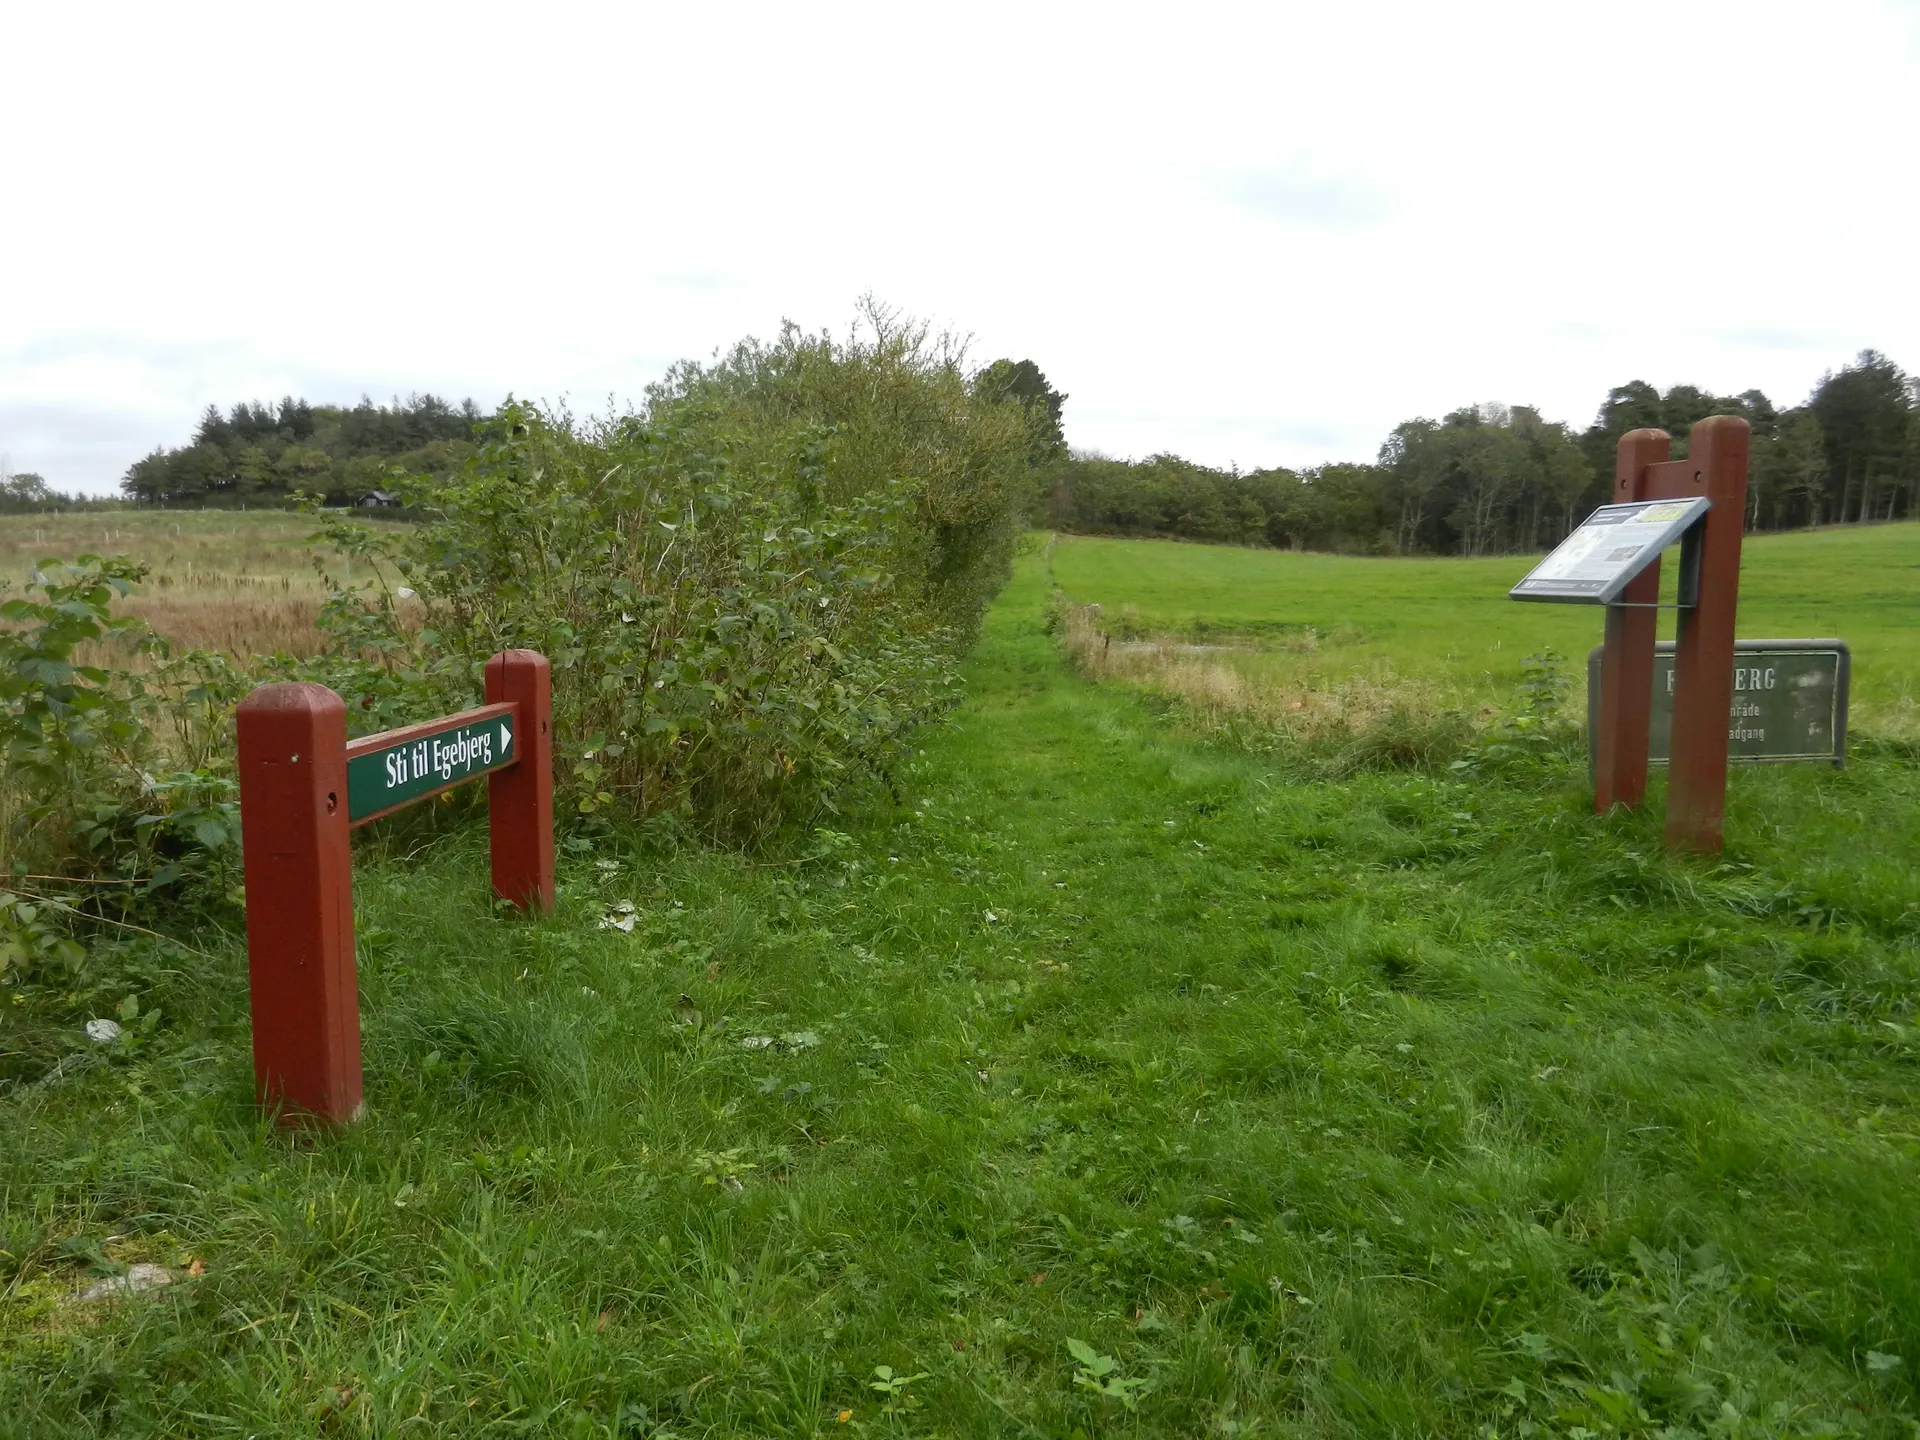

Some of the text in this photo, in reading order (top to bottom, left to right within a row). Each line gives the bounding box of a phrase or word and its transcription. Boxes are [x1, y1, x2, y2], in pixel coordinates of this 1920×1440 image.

[386, 729, 492, 788] Sti til Egebjerg
